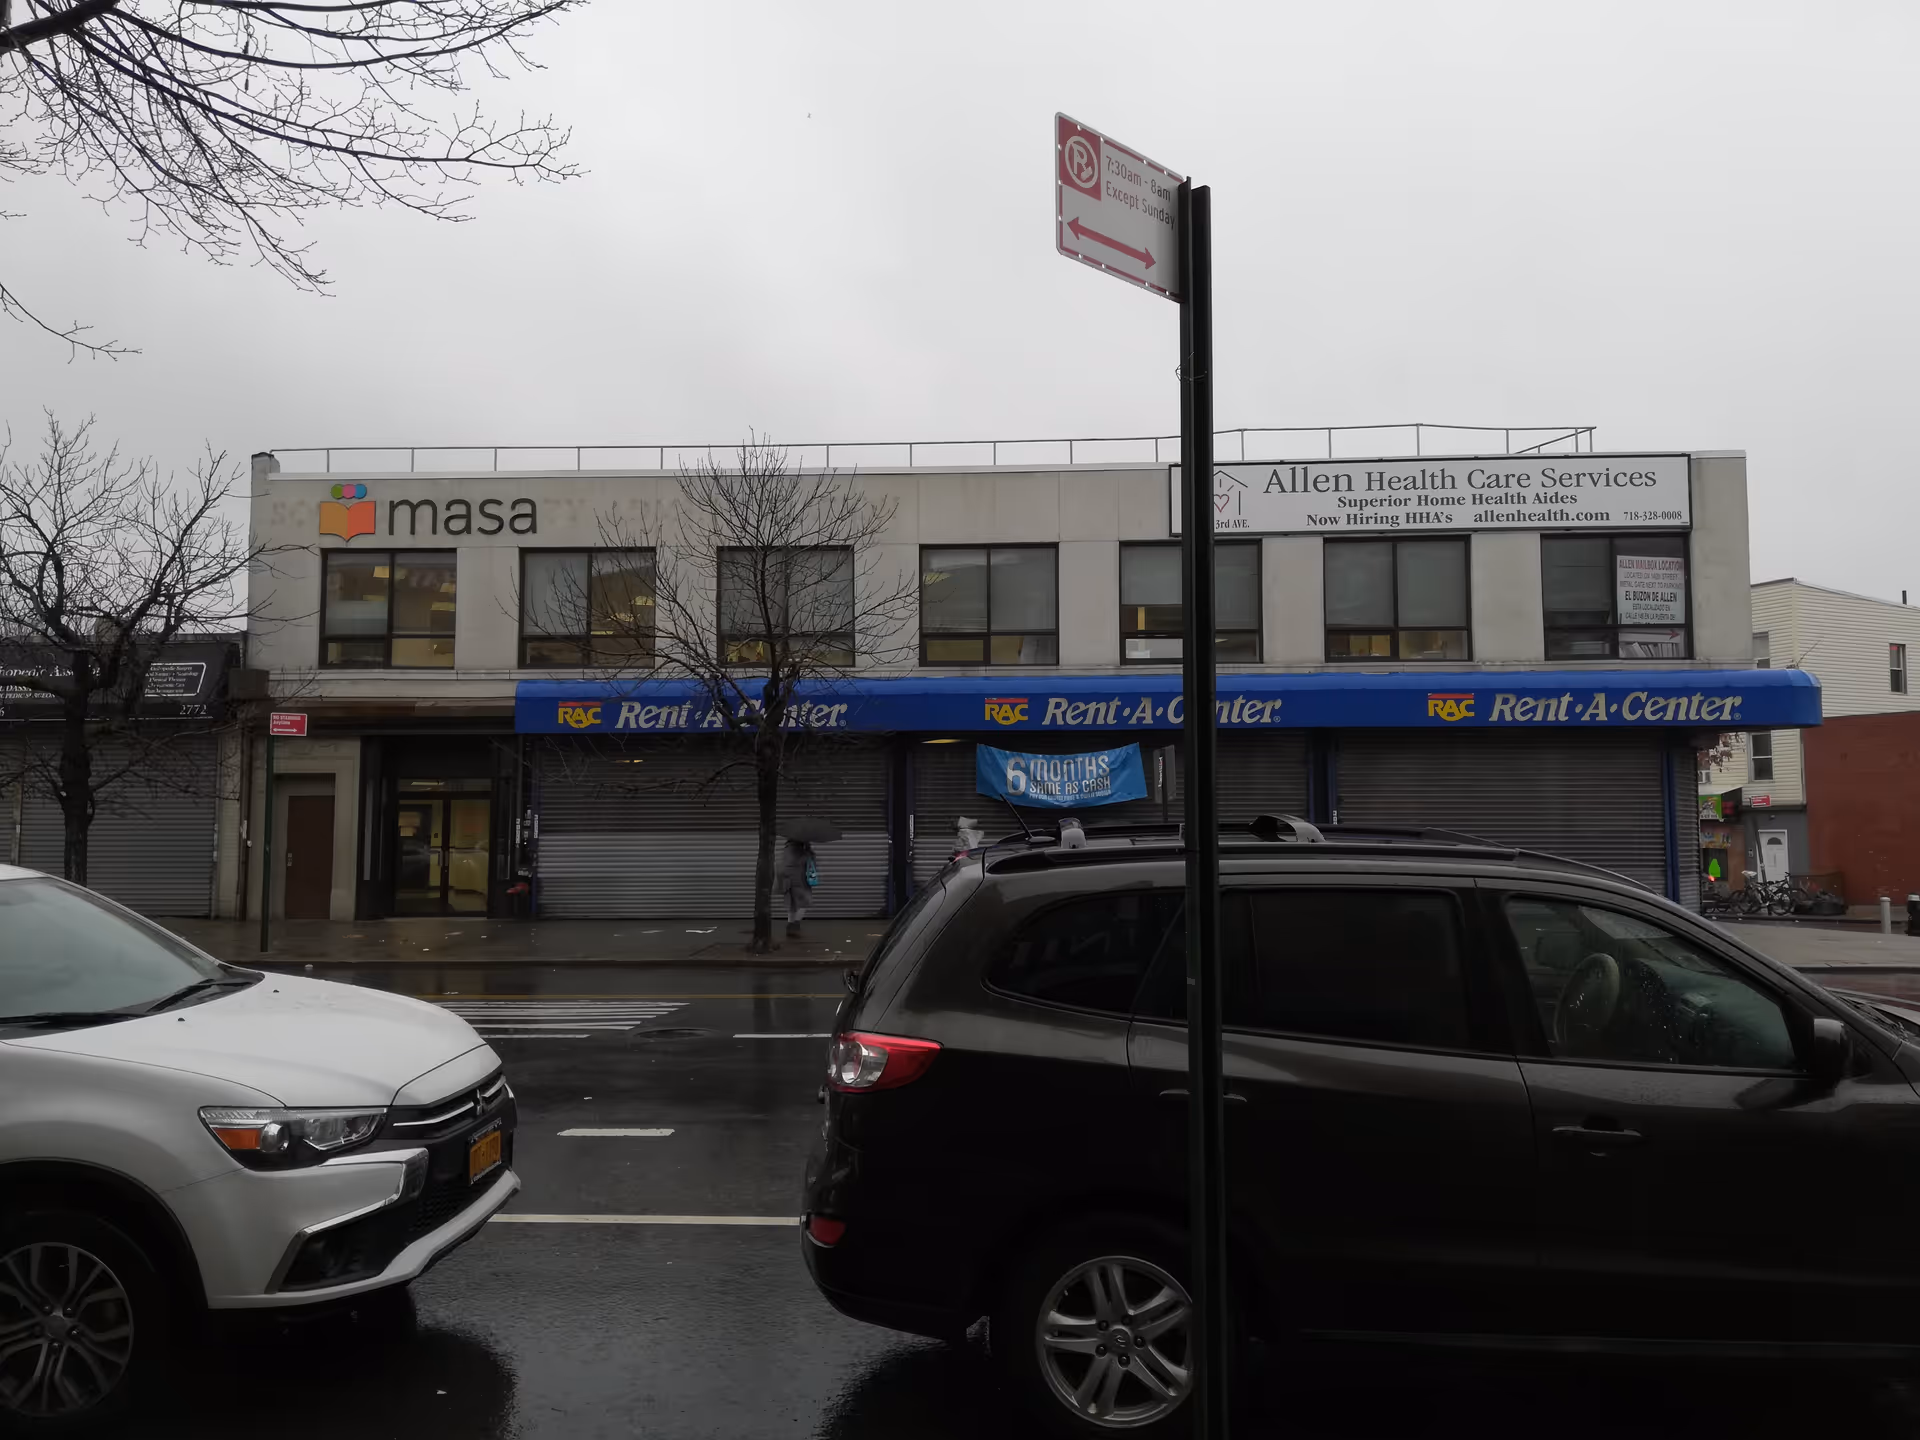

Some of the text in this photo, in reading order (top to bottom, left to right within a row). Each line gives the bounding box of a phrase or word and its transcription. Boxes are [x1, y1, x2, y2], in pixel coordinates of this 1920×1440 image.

[1106, 155, 1142, 187] 7:30am
[1150, 179, 1172, 202] 8am
[1106, 180, 1176, 231] Except Sunday
[1263, 466, 1657, 494] Allen Health Care Services
[1337, 491, 1578, 511] Superior Home Health Aides
[388, 497, 537, 536] masa
[1215, 519, 1250, 529] 3rd AVE.
[1306, 511, 1453, 528] Now Hiring HHA's
[1474, 509, 1610, 523] allenhealth.com
[1623, 511, 1682, 522] 718-328-0008
[1625, 591, 1632, 601] EL
[1652, 592, 1659, 602] DE
[1660, 592, 1677, 602] ALLEN
[180, 703, 207, 715] 2772
[558, 706, 602, 729] RAC
[985, 702, 1028, 726] RAC
[1428, 698, 1474, 721] RAC
[1006, 755, 1110, 796] 6 MONTHS
[1030, 776, 1111, 795] SAME AS CASH
